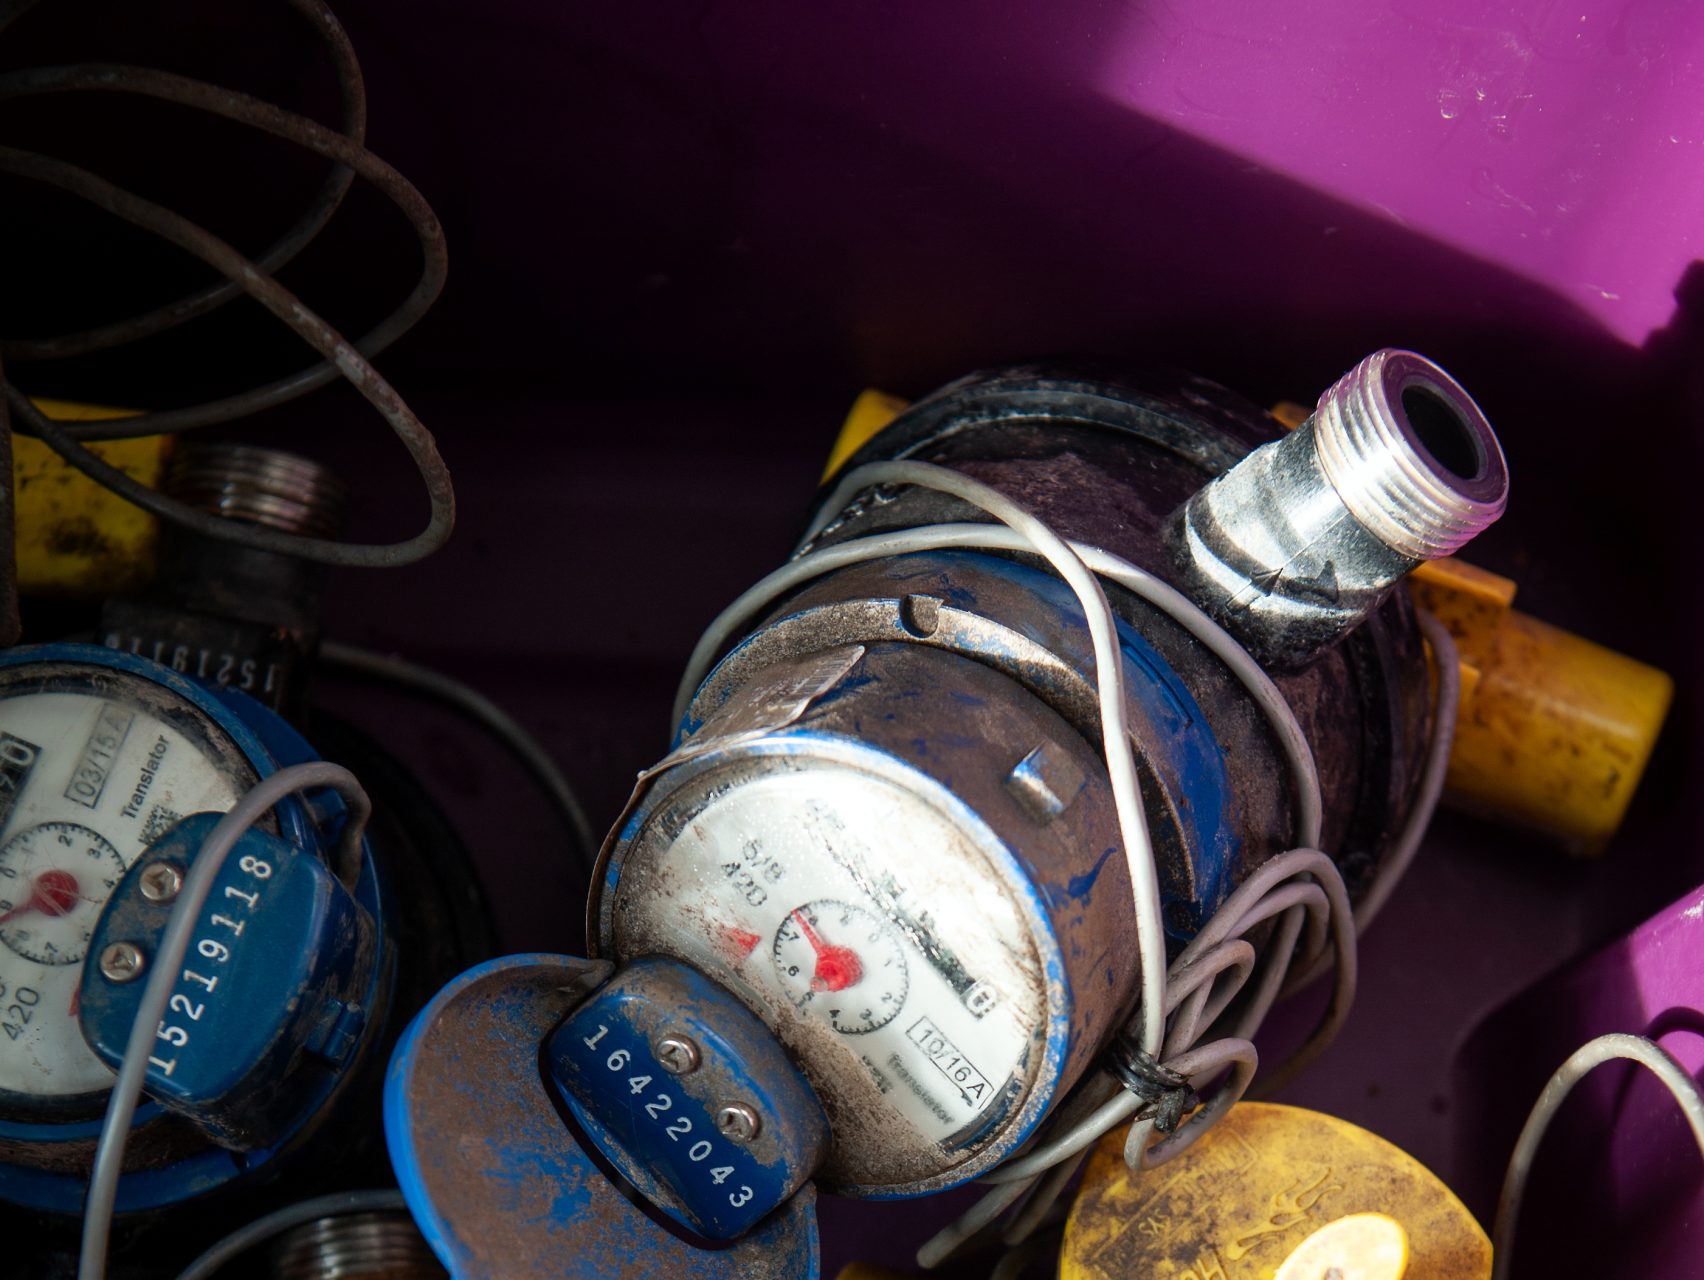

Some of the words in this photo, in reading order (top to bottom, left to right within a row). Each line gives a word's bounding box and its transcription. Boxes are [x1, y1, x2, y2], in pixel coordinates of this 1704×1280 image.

[120, 734, 169, 819] Translator
[2, 986, 40, 1041] 420
[148, 855, 272, 1076] 15219118
[583, 1024, 753, 1208] 16422043
